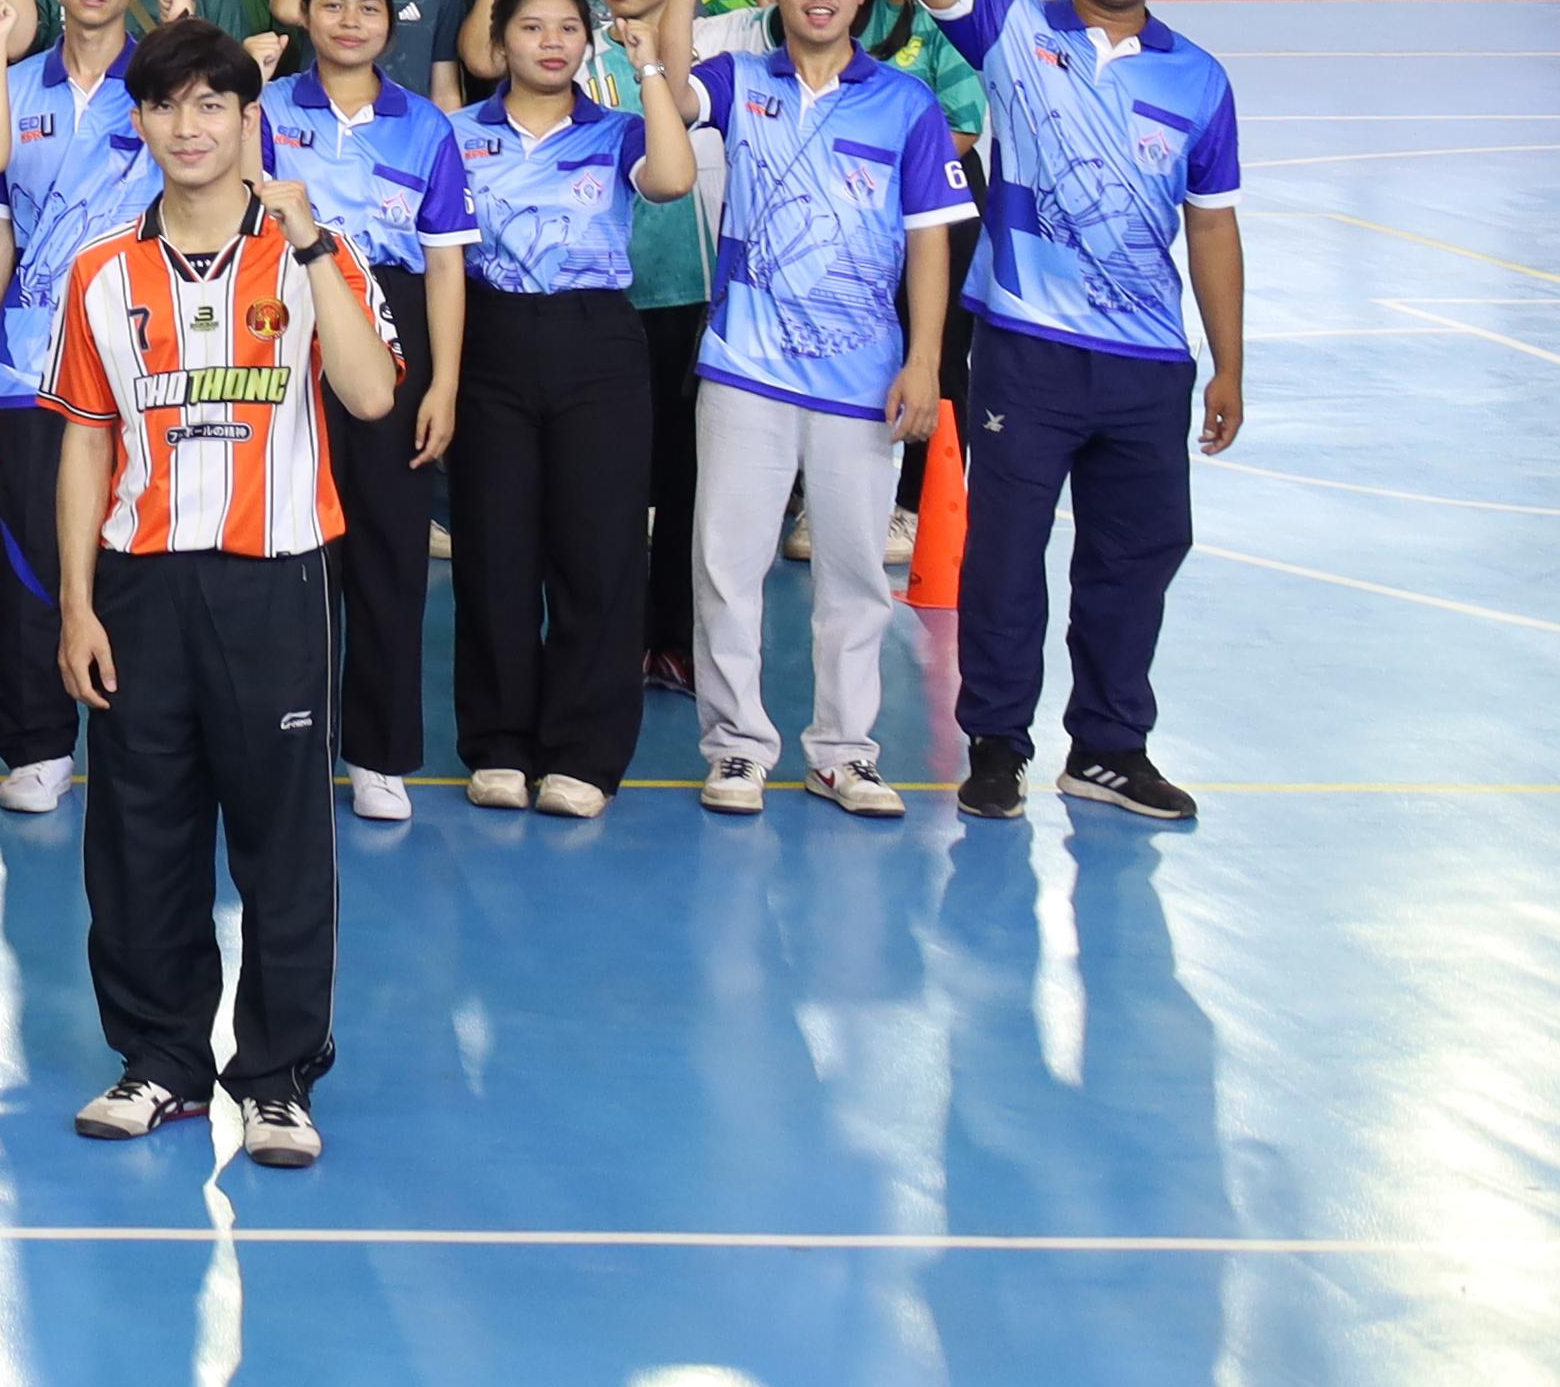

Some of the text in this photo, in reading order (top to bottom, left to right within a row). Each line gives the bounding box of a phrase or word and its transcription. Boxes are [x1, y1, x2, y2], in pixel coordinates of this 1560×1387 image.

[18, 112, 56, 138] EDU
[277, 126, 314, 149] EDU
[944, 159, 969, 191] 6
[127, 306, 151, 351] 7
